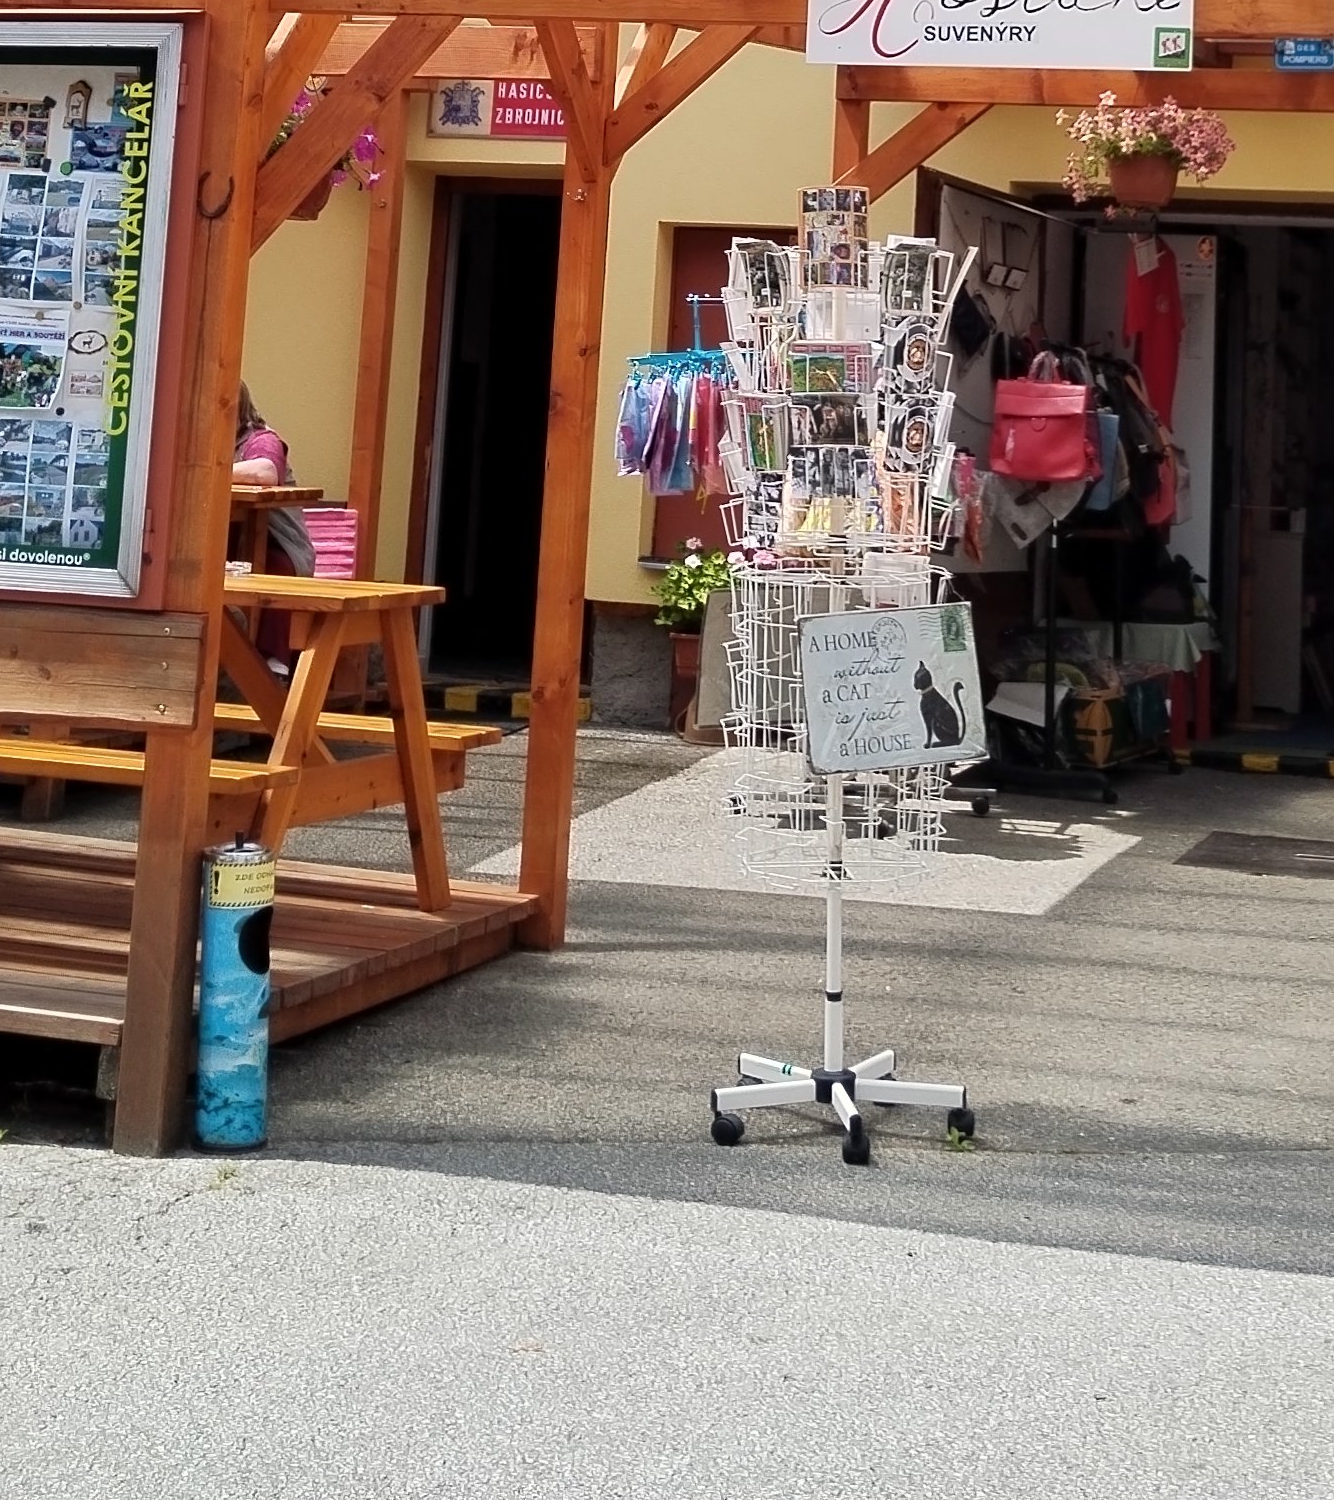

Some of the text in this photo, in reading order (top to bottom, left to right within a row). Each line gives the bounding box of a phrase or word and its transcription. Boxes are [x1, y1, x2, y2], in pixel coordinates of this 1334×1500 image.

[923, 21, 1037, 42] SUVENÝRY
[105, 81, 153, 436] CESTOVNÍ KANCELÁŘ
[809, 631, 877, 652] A HOME
[834, 648, 905, 678] without
[822, 682, 871, 703] a CAT
[835, 701, 905, 742] is just
[839, 743, 849, 756] a
